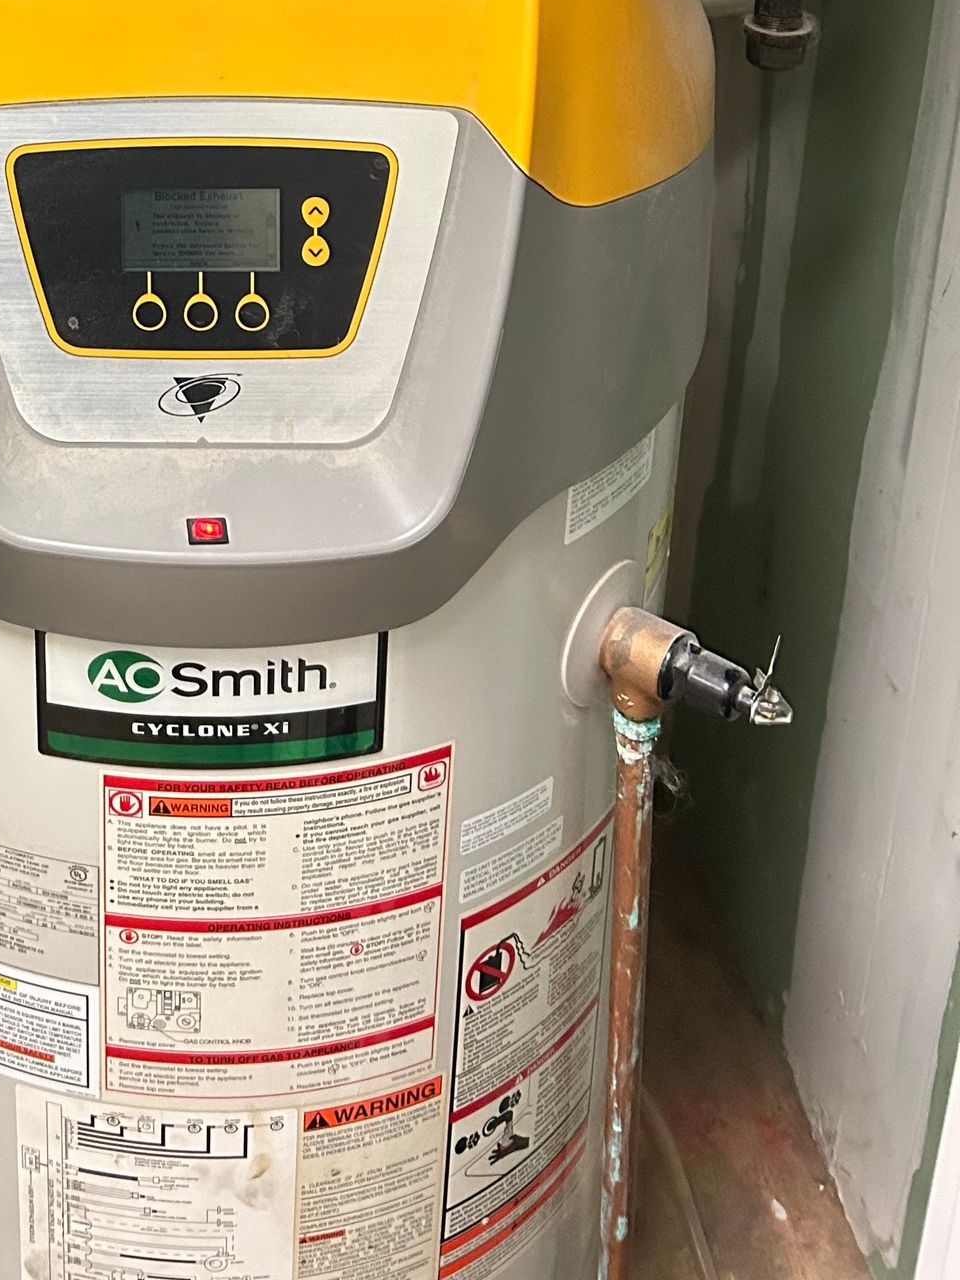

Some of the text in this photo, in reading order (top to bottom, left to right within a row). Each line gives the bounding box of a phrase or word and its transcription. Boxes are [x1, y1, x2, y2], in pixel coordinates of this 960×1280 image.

[155, 191, 243, 201] Blocked Exhaust
[263, 722, 289, 735] Xi
[158, 762, 406, 792] FOR YOUR SAFETY READ BEFORE OPERATING
[270, 797, 286, 805] follow
[304, 793, 336, 802] instructions
[380, 778, 405, 790] explosion
[171, 803, 229, 813] WARNING
[264, 805, 288, 814] causing
[289, 803, 310, 812] property
[335, 796, 358, 807] personal
[360, 792, 375, 803] injury
[151, 849, 194, 857] OPERATING
[208, 912, 352, 932] OPERATING INSTRUCTIONS
[208, 1056, 235, 1064] TURN
[238, 1056, 257, 1064] OFF
[261, 1053, 284, 1062] GAS
[288, 1051, 301, 1060] TO
[303, 1041, 361, 1058] APPLIANCE
[334, 1083, 436, 1124] WARNING
